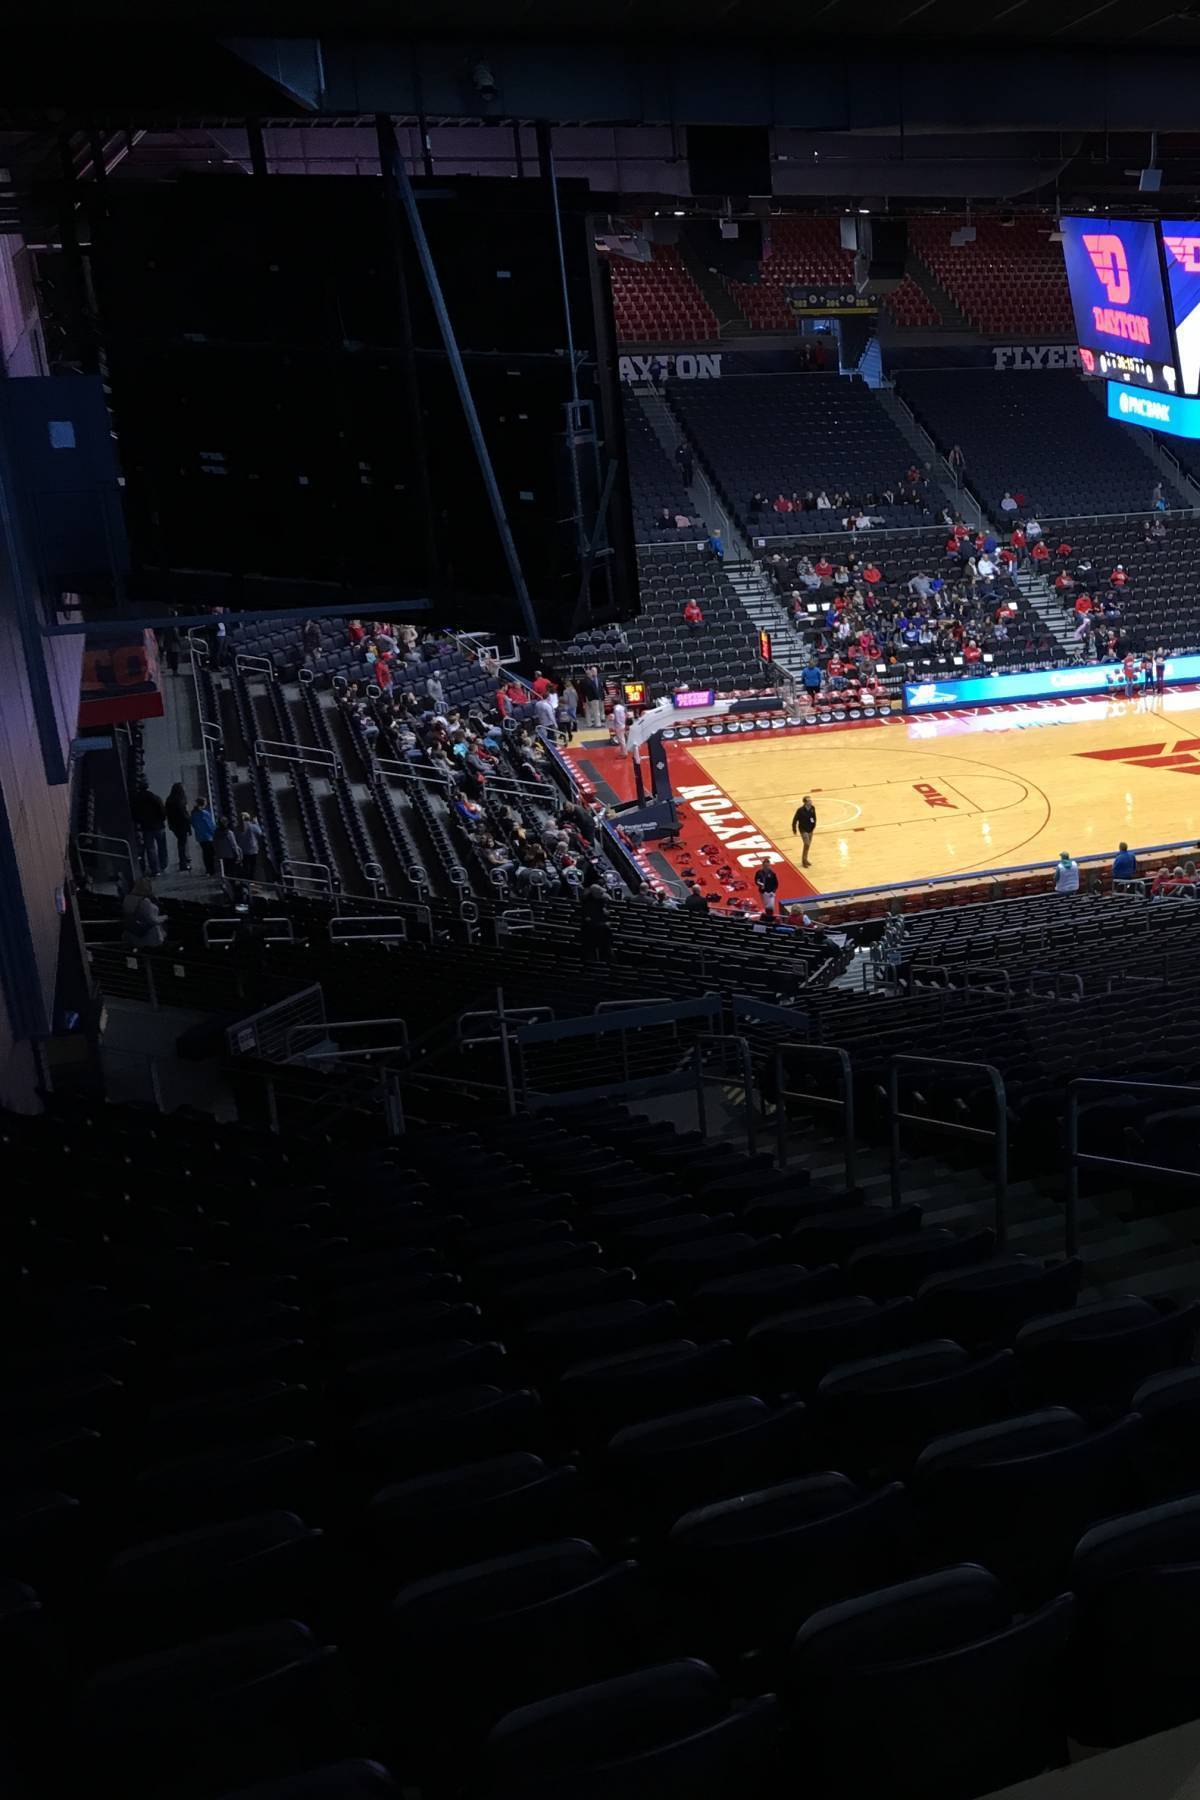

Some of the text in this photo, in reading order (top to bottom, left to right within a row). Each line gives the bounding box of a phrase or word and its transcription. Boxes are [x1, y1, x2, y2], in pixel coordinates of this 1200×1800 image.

[1092, 306, 1151, 345] DAYTON
[618, 354, 722, 381] AYTON
[993, 345, 1080, 370] FLYER
[880, 692, 1119, 726] UNIVERSITY
[676, 784, 785, 868] DAYTON
